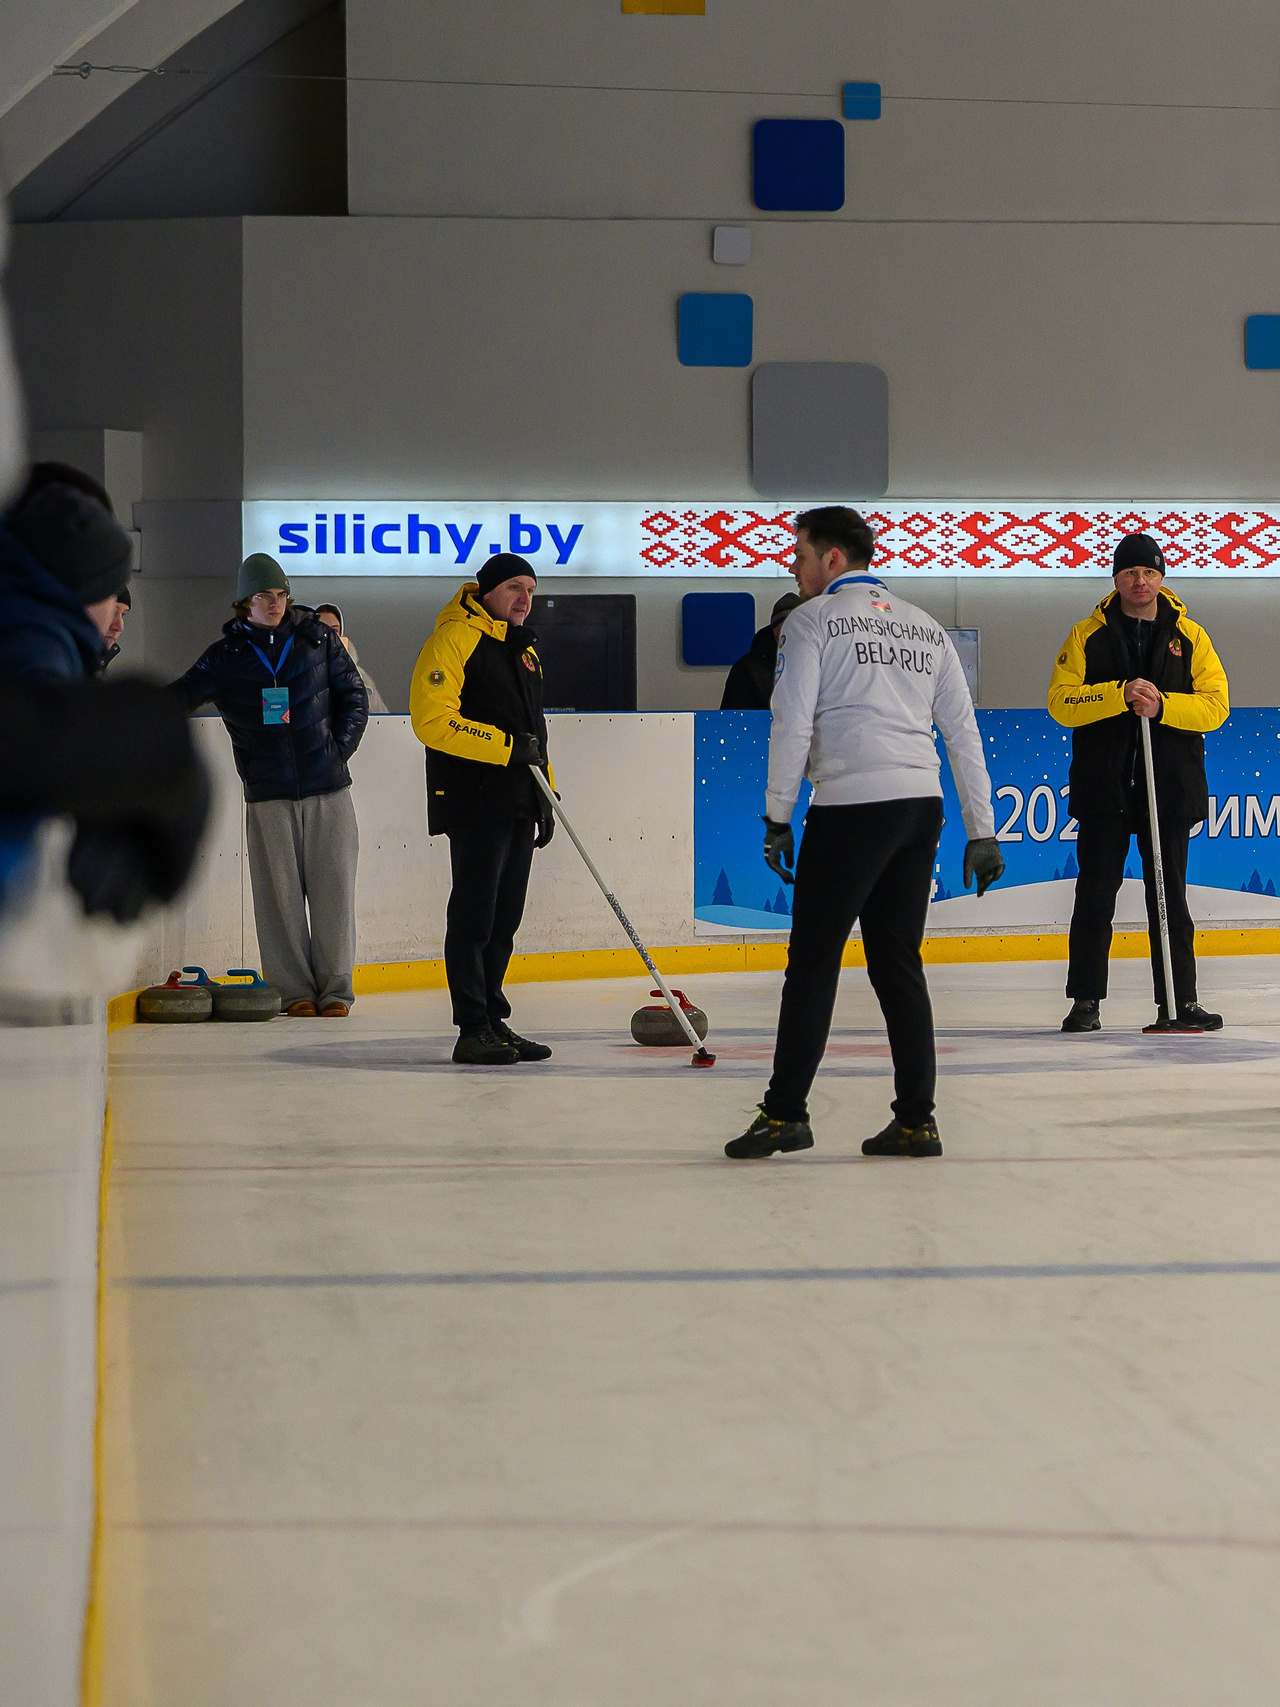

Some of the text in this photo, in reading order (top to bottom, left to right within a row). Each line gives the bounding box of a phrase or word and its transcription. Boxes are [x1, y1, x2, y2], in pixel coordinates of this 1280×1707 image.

[279, 513, 584, 564] silichy.by
[827, 616, 945, 649] DZIANESHCHANKA
[855, 642, 933, 675] BELARUS
